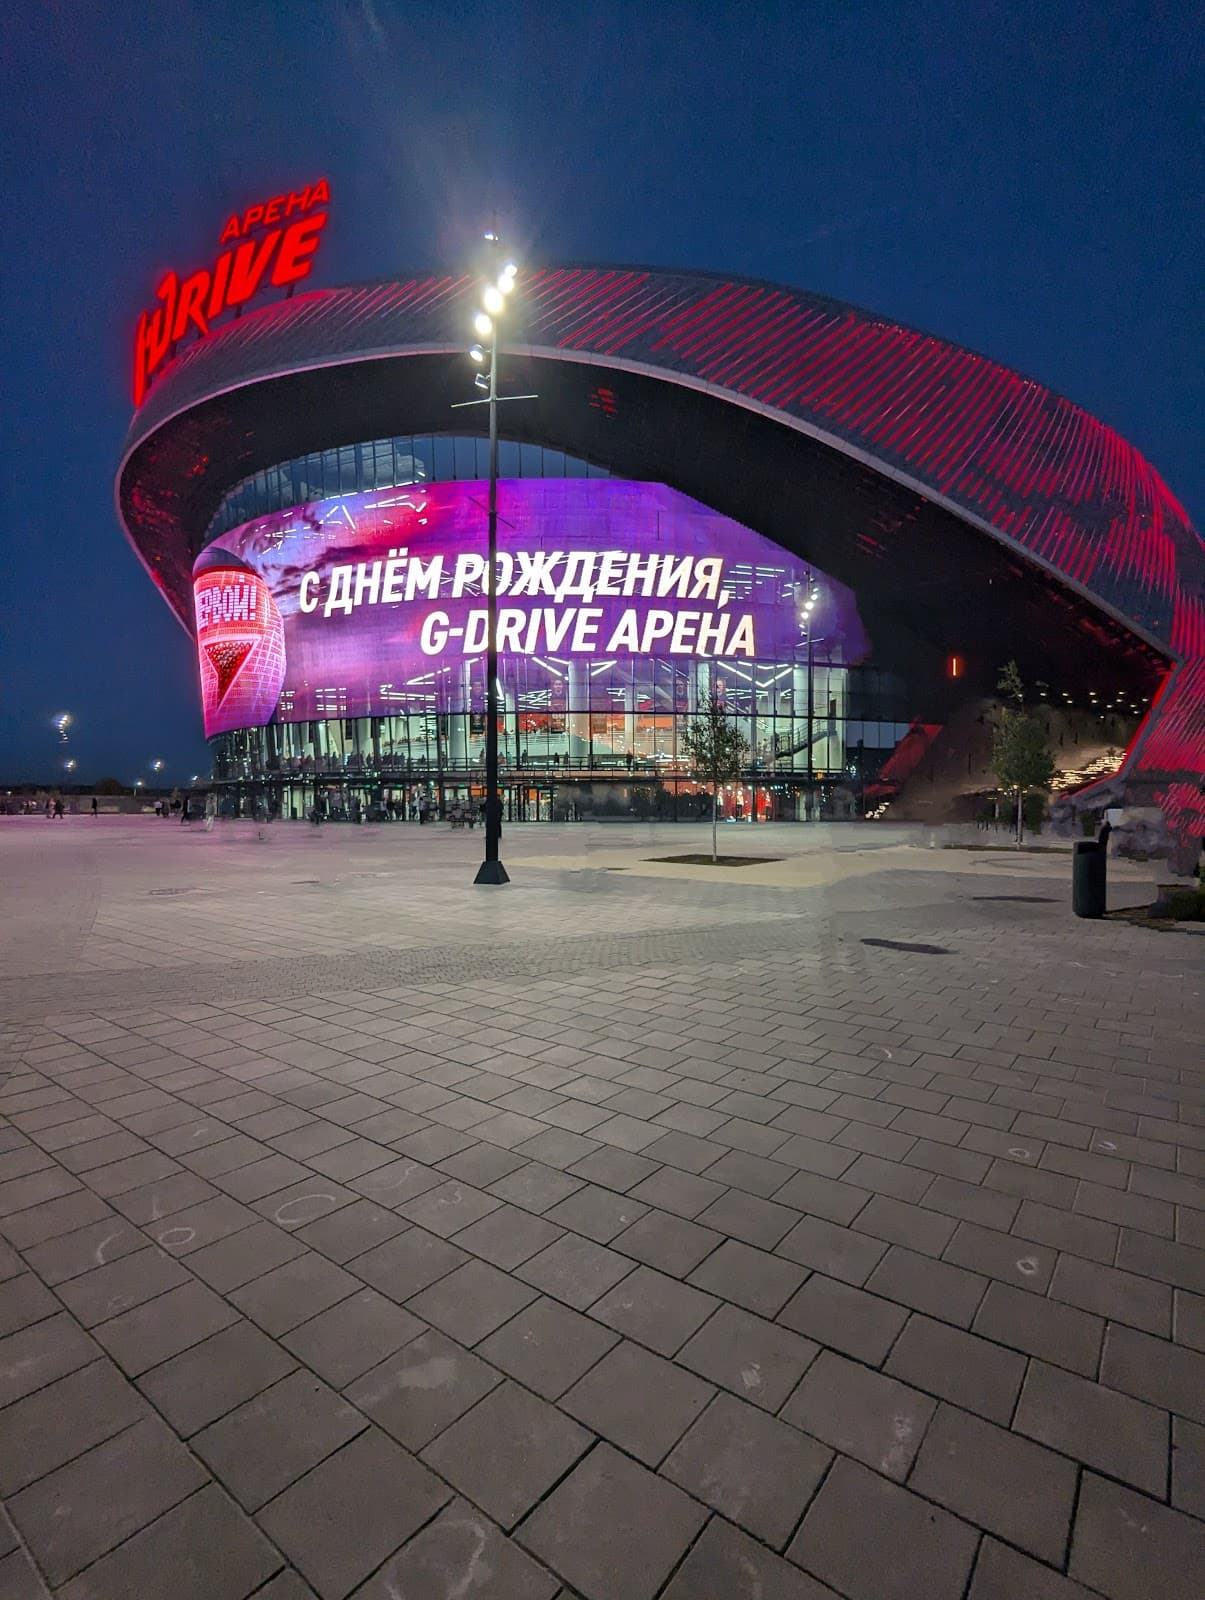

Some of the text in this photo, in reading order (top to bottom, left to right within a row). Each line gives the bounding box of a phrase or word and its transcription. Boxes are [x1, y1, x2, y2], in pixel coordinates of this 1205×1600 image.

[220, 178, 330, 245] АРЕНА
[299, 547, 730, 618] С ДНЁМ РОЖДЕНИЯ,
[420, 608, 755, 657] G-DRIVE АРЕНА
